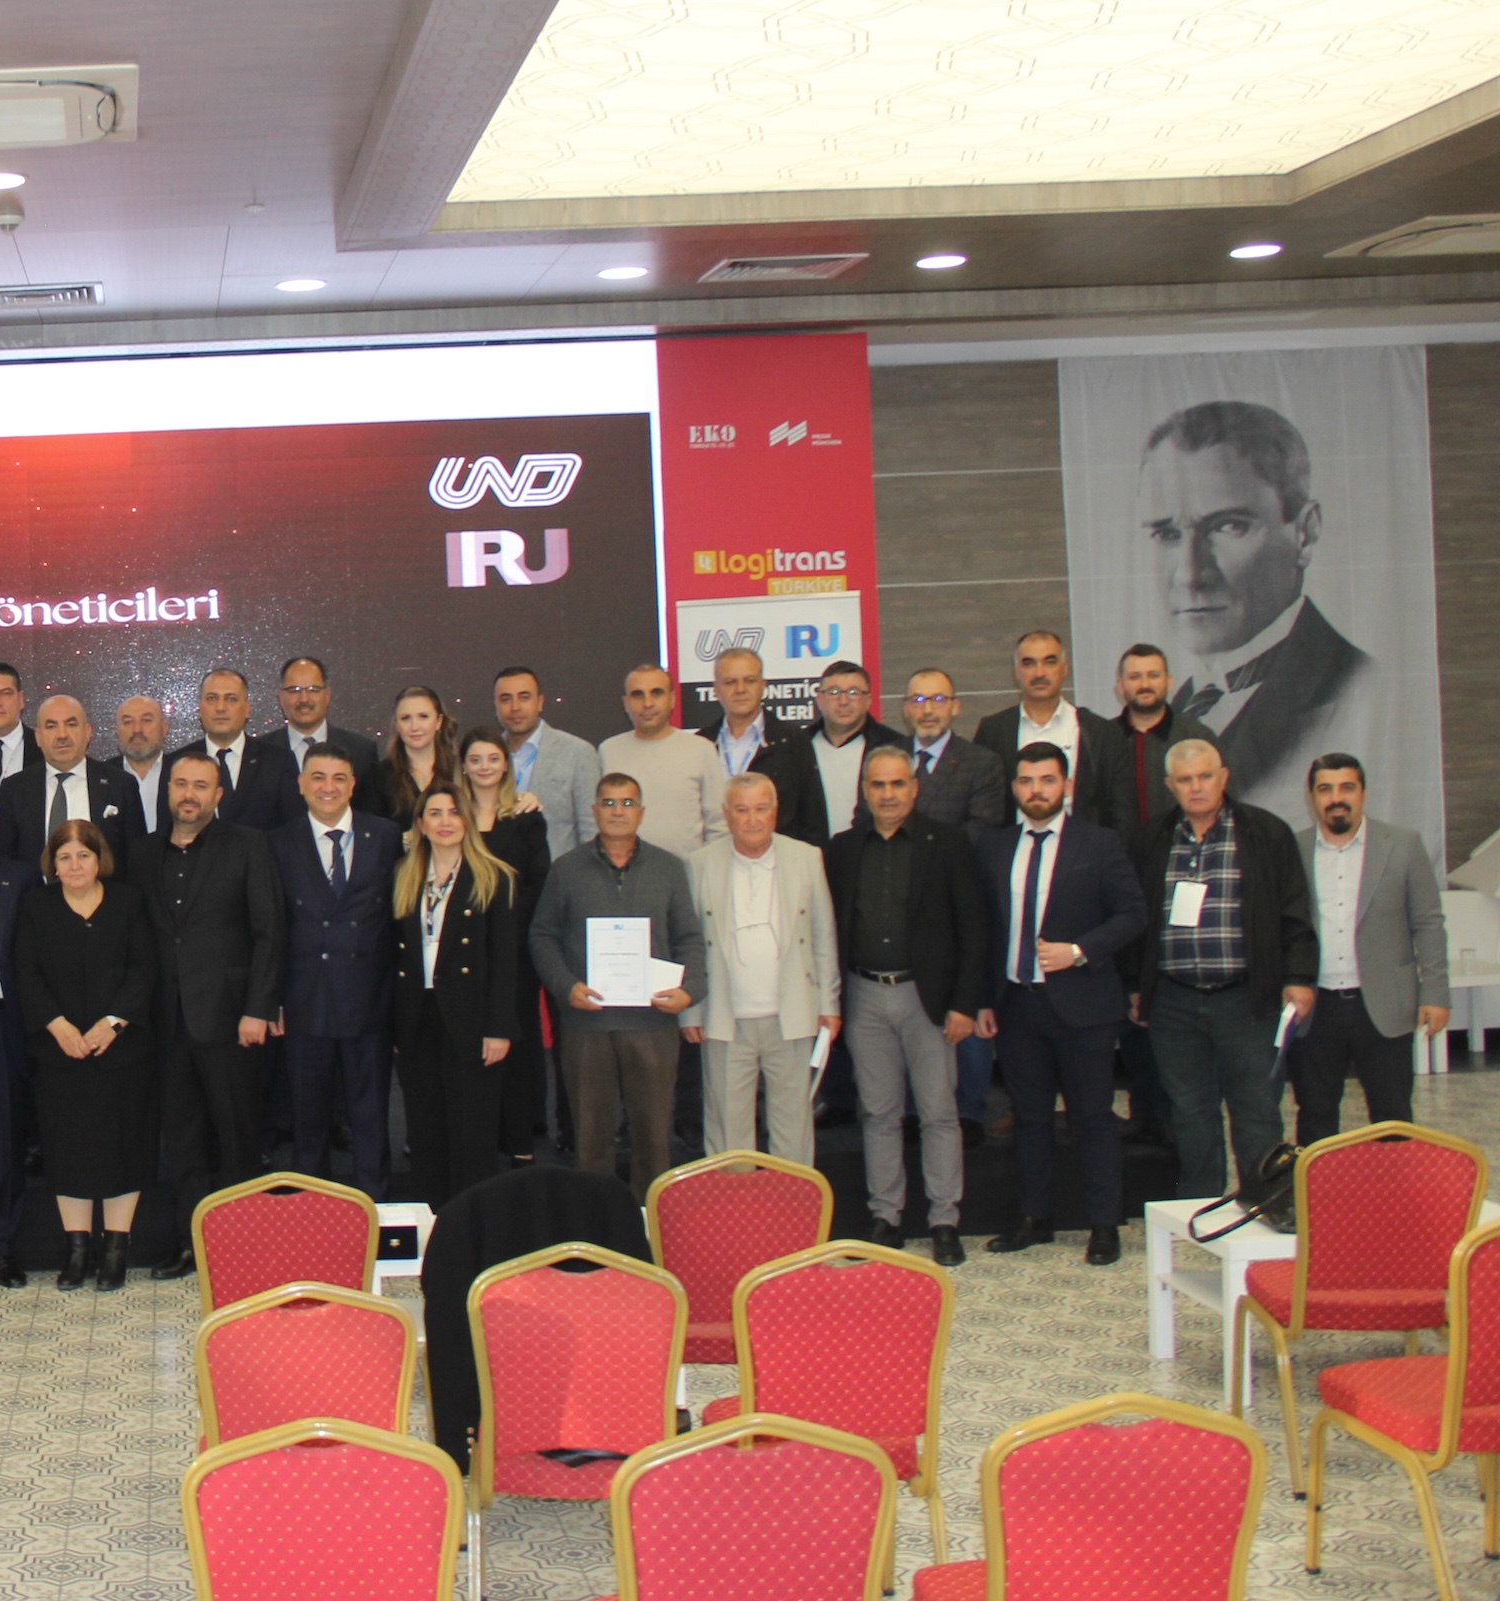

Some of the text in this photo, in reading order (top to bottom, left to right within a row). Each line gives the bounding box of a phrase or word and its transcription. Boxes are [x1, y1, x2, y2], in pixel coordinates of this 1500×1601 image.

[689, 424, 736, 443] EKO
[428, 453, 583, 509] UND
[446, 528, 569, 587] IRU
[719, 548, 846, 580] logitrans
[771, 577, 842, 594] TÜRKİYE
[785, 623, 840, 659] IRU
